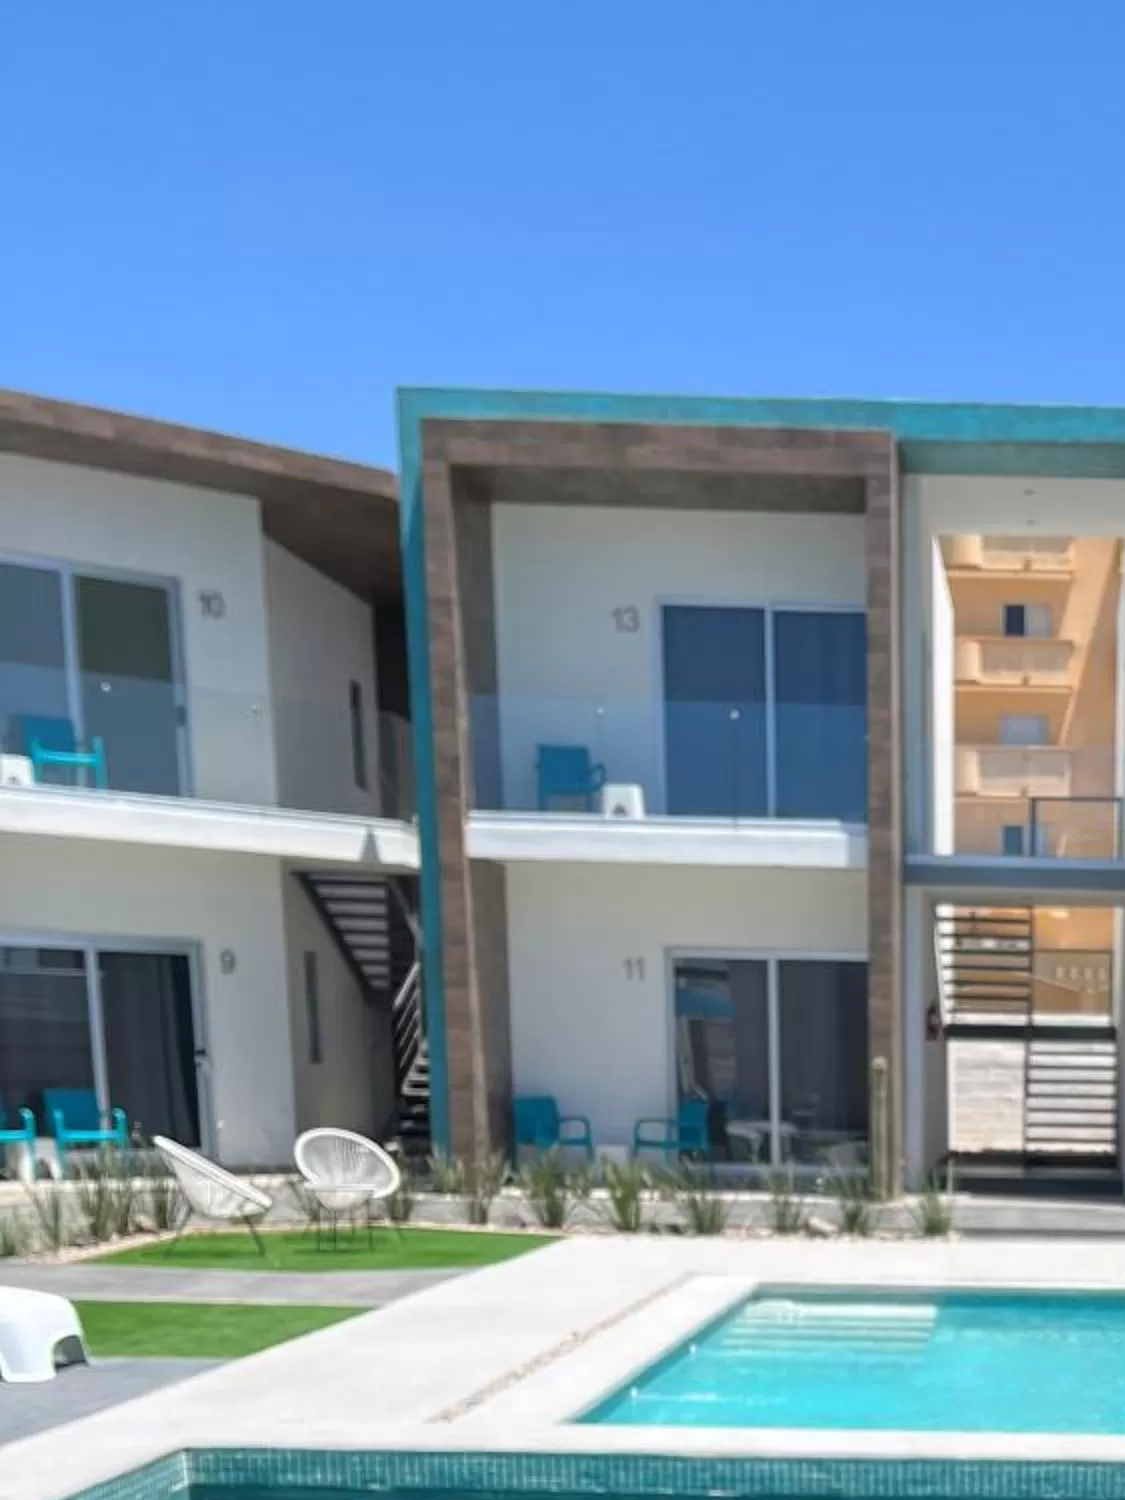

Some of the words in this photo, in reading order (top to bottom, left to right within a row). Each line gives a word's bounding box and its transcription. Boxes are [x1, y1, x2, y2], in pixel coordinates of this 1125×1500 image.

[198, 591, 226, 619] 10
[612, 605, 640, 633] 13
[623, 957, 645, 982] 11
